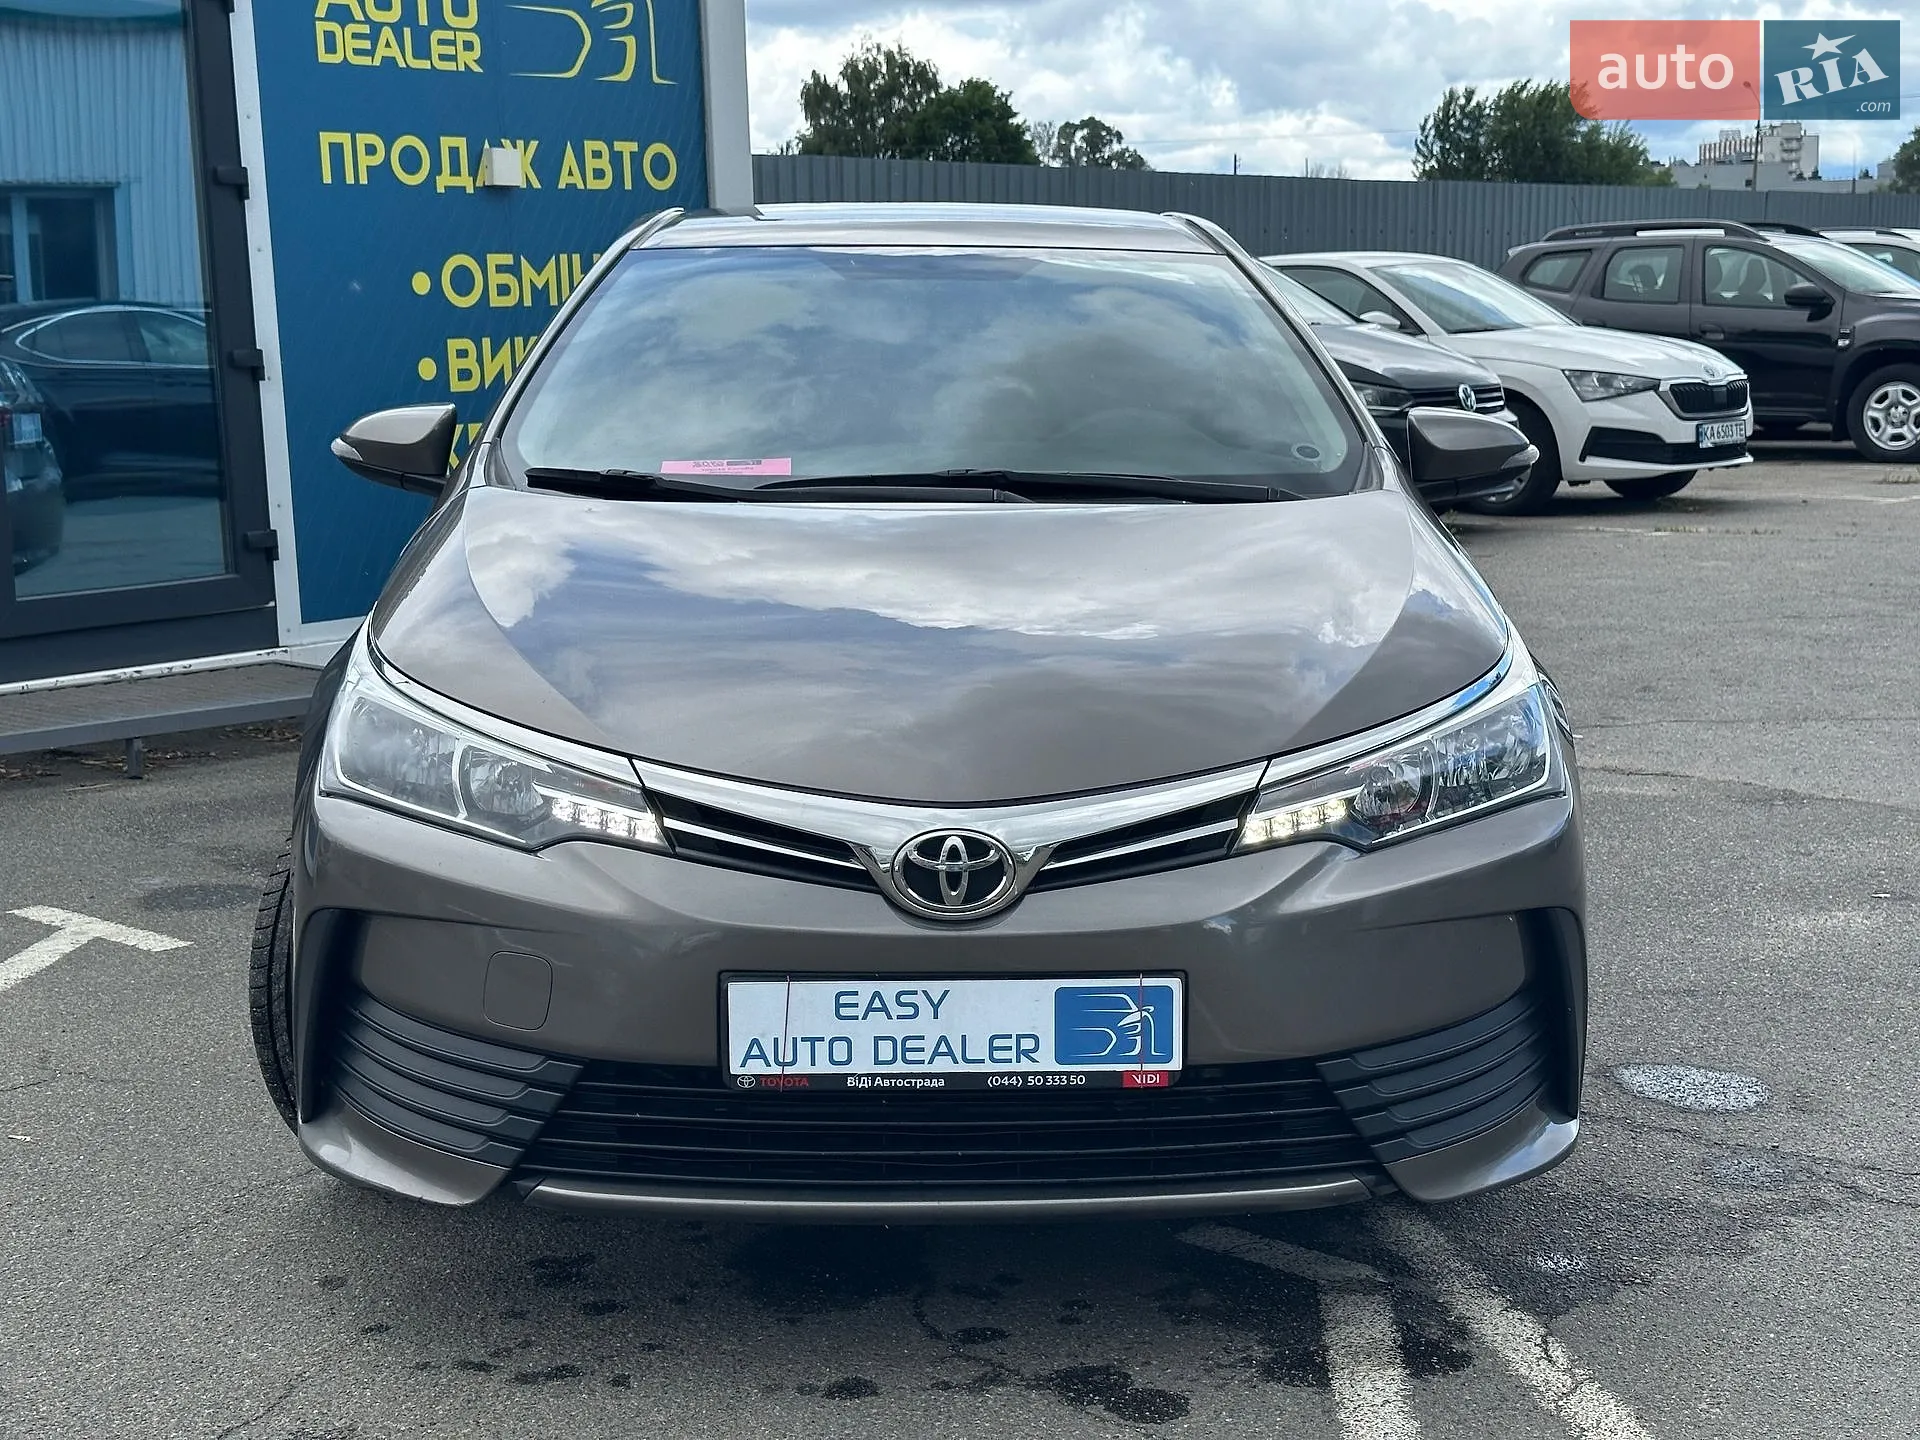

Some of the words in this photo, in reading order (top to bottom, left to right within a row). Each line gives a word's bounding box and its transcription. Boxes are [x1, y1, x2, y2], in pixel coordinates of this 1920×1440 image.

[315, 21, 483, 72] DEALER
[558, 140, 678, 191] АВТО
[1717, 424, 1734, 440] 6503
[834, 989, 950, 1021] EASY
[740, 1035, 853, 1068] AUTO
[873, 1033, 1041, 1067] DEALER
[760, 1077, 809, 1087] TOYOTA
[874, 1076, 945, 1089] Автострада
[987, 1075, 1023, 1088] (044)
[1131, 1074, 1160, 1085] VIDI
